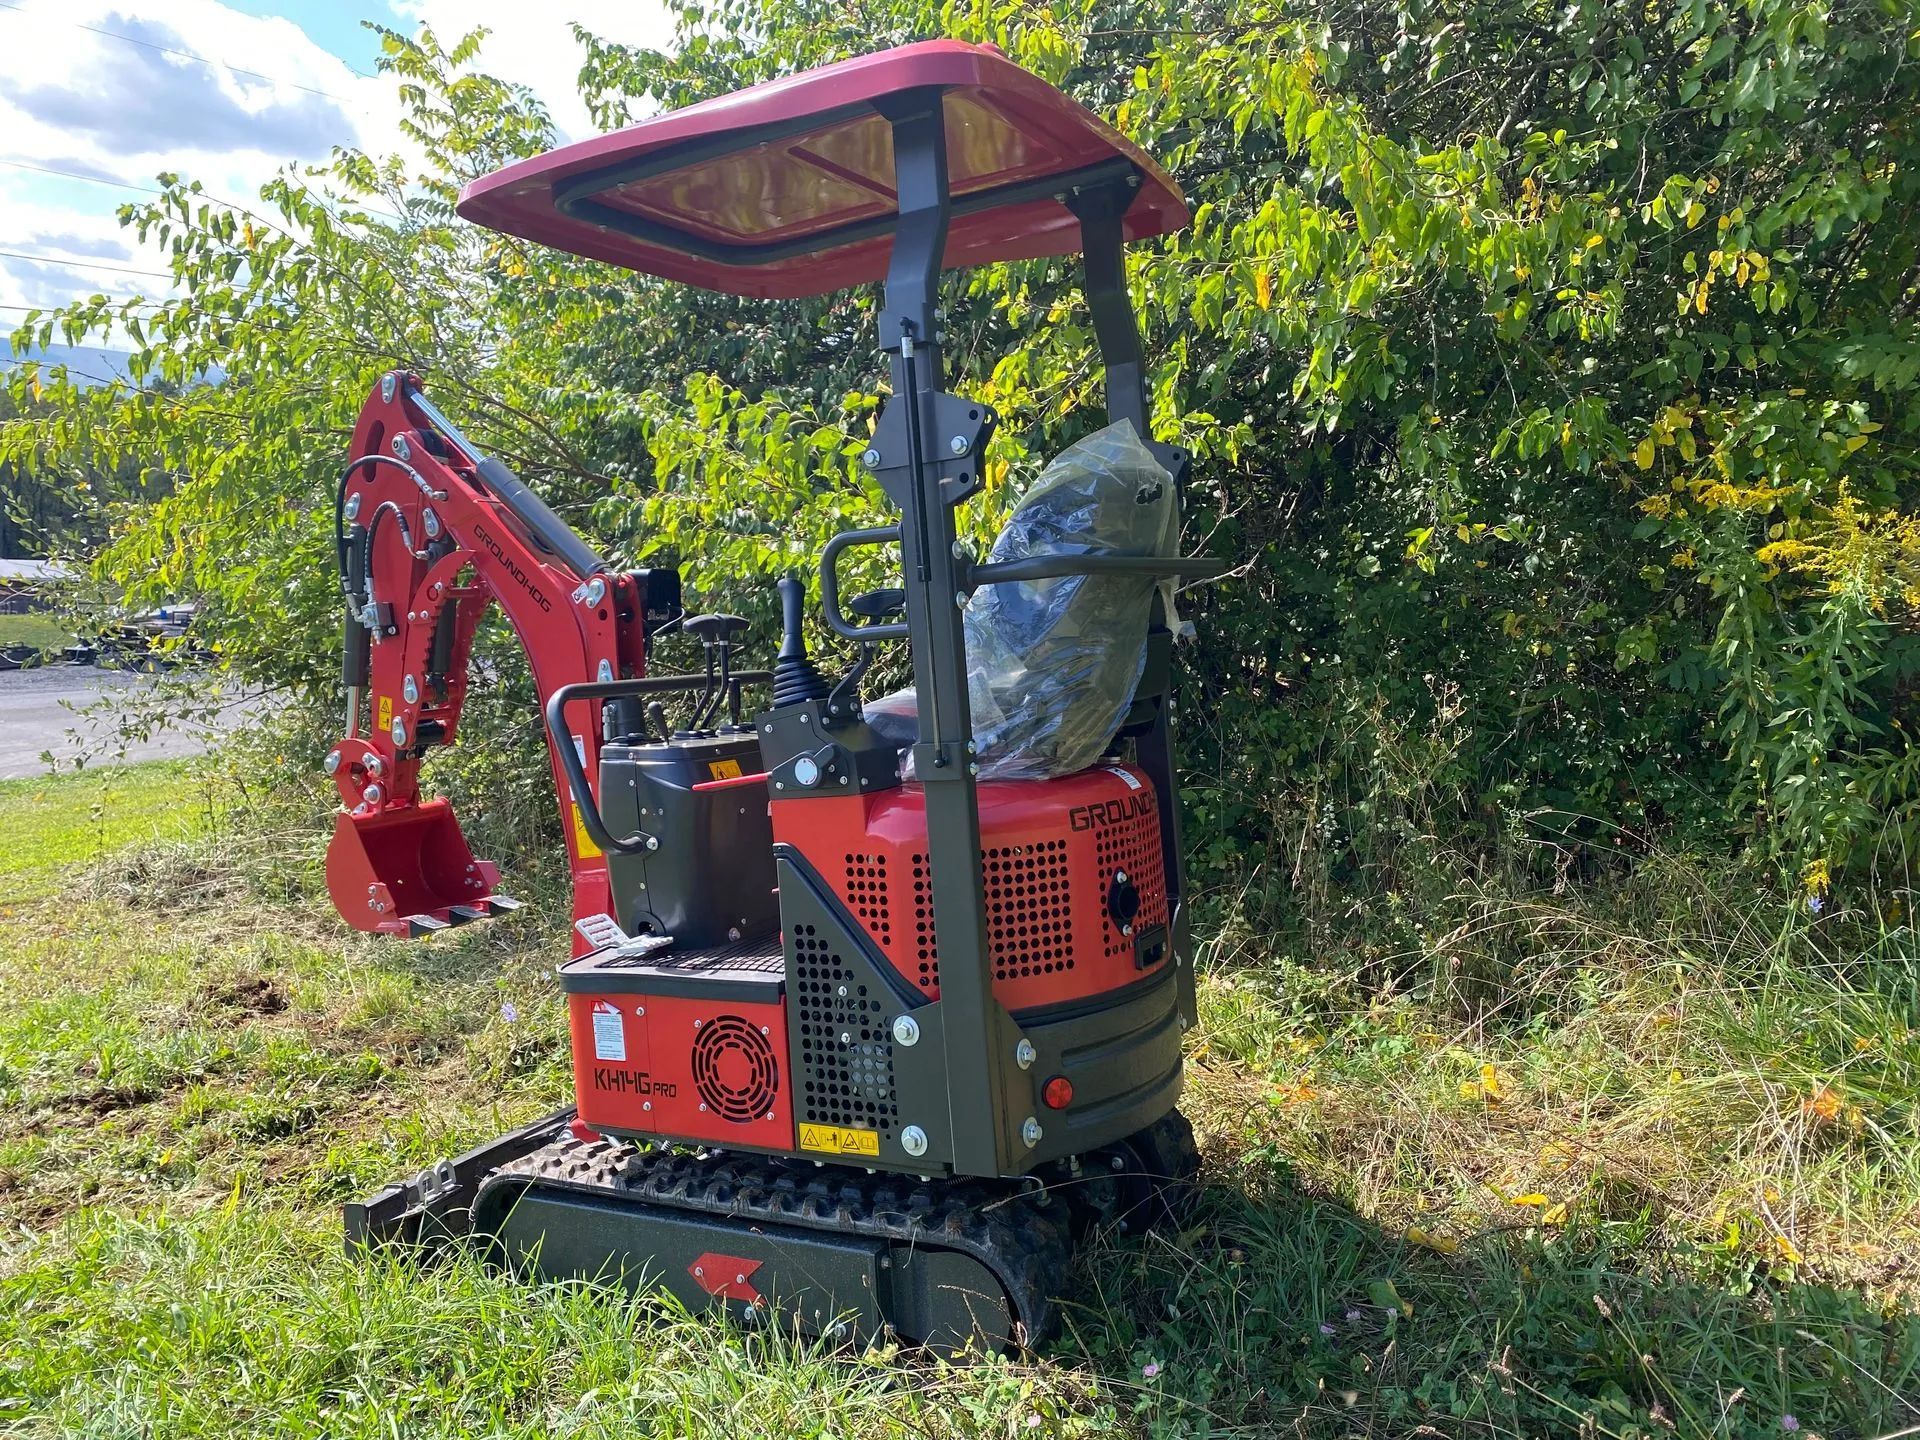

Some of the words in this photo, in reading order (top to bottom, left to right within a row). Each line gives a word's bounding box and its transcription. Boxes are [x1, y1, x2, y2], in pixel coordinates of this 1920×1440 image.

[474, 524, 551, 613] GROUNDHOG
[1069, 791, 1154, 832] GROUND
[594, 1067, 650, 1095] KH14G
[653, 1082, 676, 1098] PRO
